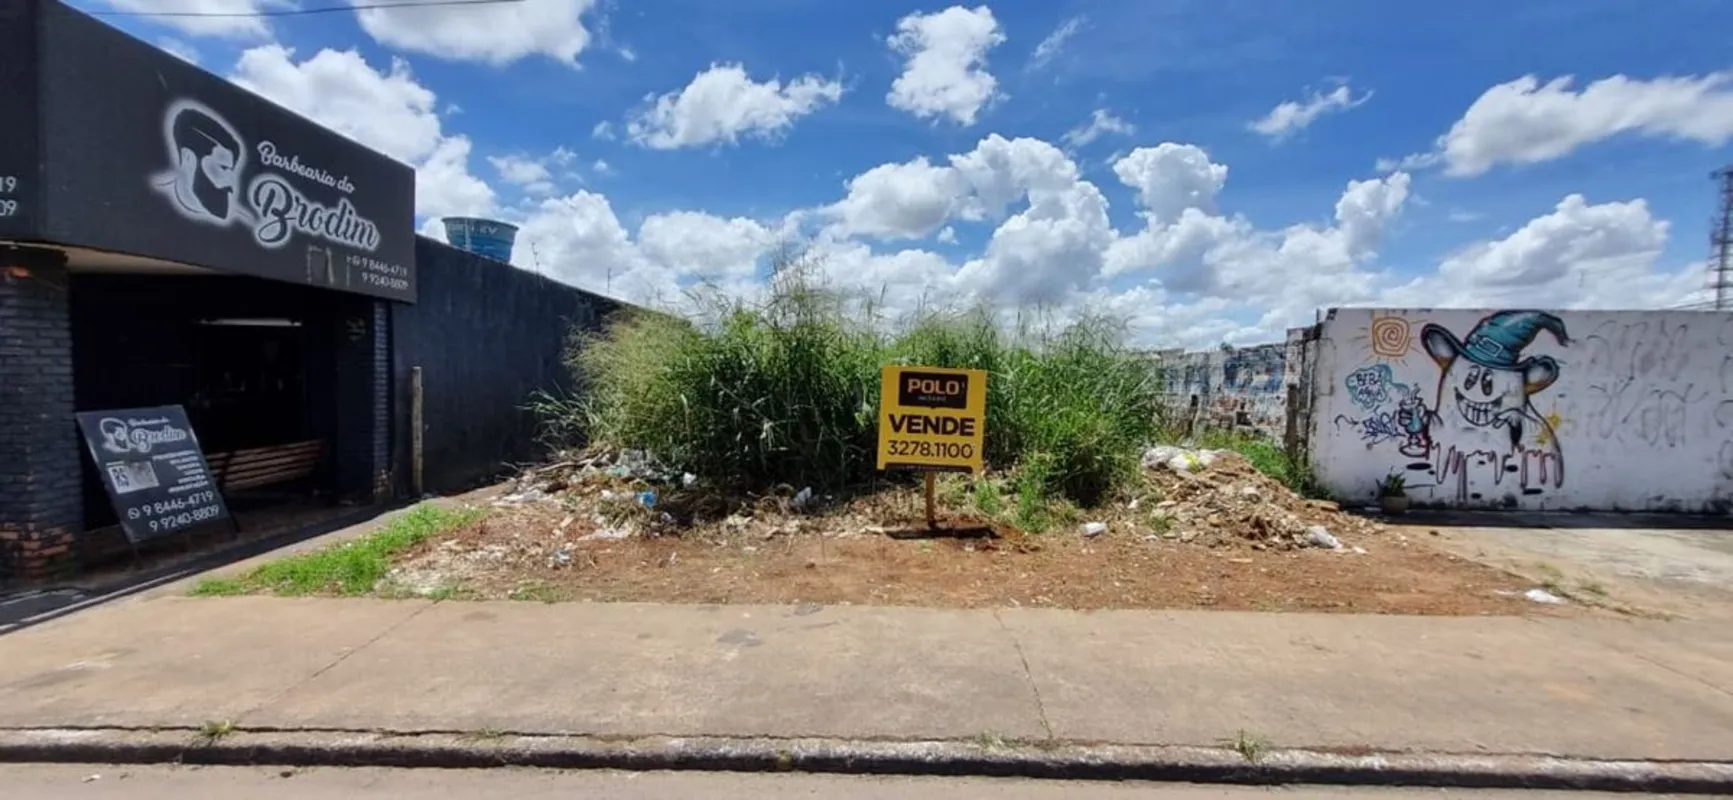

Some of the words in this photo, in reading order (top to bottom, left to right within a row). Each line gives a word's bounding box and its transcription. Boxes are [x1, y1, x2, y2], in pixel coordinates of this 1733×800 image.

[257, 141, 336, 187] Barbearia
[337, 175, 355, 194] do
[250, 176, 379, 248] Brodim
[362, 257, 368, 268] 9
[362, 272, 368, 282] 9
[907, 379, 960, 396] POLO
[888, 414, 975, 436] VENDE
[887, 440, 973, 459] 3278.1100
[142, 504, 152, 517] 9
[154, 490, 213, 514] 8446-4719
[149, 520, 158, 532] 9
[160, 504, 219, 529] 9240-8809
